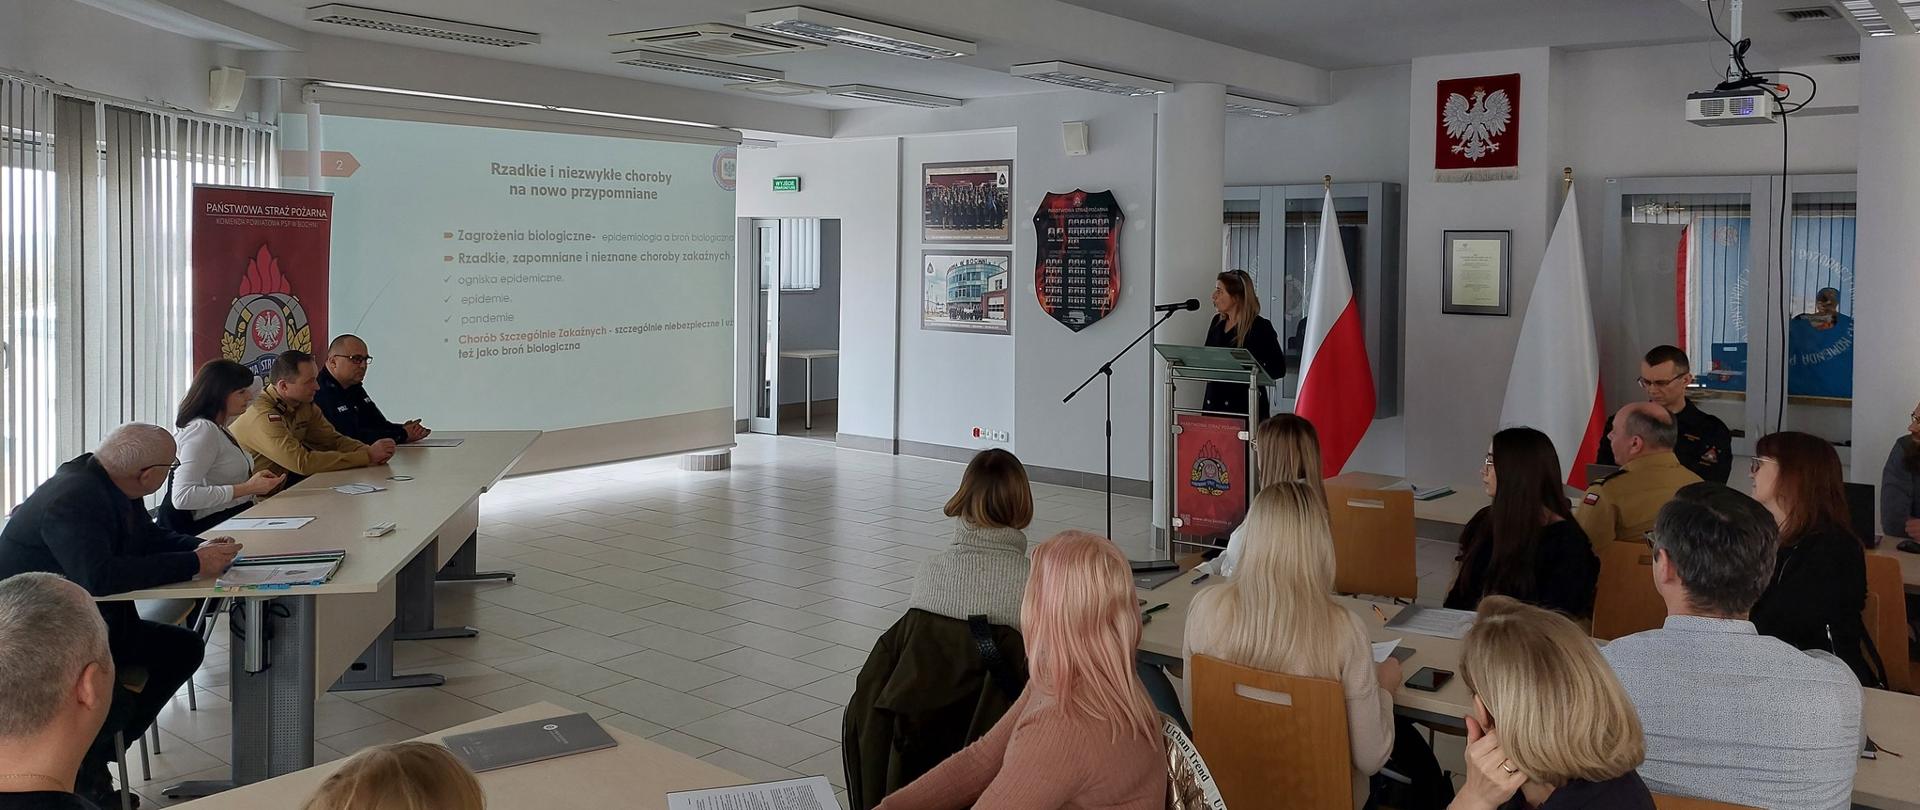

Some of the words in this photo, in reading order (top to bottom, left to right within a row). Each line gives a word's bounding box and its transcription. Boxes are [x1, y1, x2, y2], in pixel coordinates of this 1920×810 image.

[335, 159, 344, 171] 2
[490, 162, 547, 178] Rzadkie
[550, 165, 554, 178] i
[558, 165, 622, 183] niezwykłe
[625, 168, 672, 185] choroby
[509, 184, 527, 196] na
[531, 185, 567, 197] nowo
[571, 186, 658, 200] przypomniane
[206, 201, 263, 215] PAŃSTWOWA
[264, 204, 290, 216] STRAŻ
[291, 205, 328, 217] POŻARNA
[216, 217, 246, 225] KOMENDA
[457, 229, 525, 243] Zagrożenia
[528, 229, 596, 243] biologiczne-
[602, 232, 662, 243] epidemiologia
[671, 232, 690, 242] broń
[457, 252, 510, 264] Rzadkie,
[512, 251, 583, 265] zapomniane
[585, 251, 589, 263] i
[591, 251, 637, 263] nieznane
[640, 251, 680, 263] choroby
[682, 249, 730, 264] zakaźnych
[457, 273, 498, 286] ogniska
[461, 312, 515, 327] pandemie
[458, 332, 498, 344] Chorób
[499, 328, 556, 342] Szczególnie
[558, 325, 607, 338] Zakaźnych
[614, 321, 663, 334] szczególnie
[664, 320, 720, 332] niebezpieczne
[457, 347, 474, 359] też
[476, 346, 499, 359] jako
[501, 344, 524, 356] broń
[527, 341, 580, 354] biologiczna
[1165, 723, 1190, 752] Urban
[1189, 750, 1210, 783] Trend
